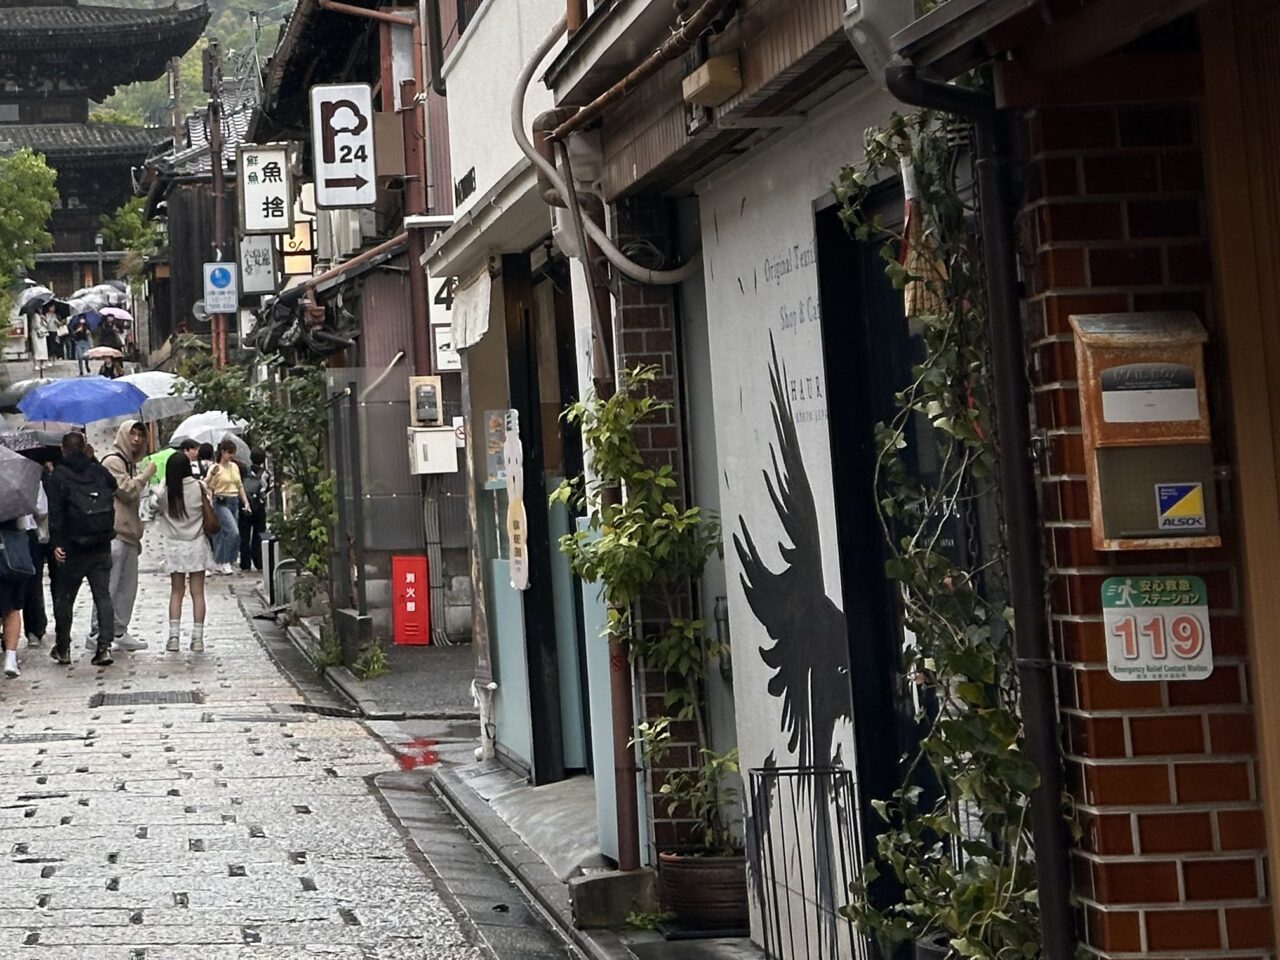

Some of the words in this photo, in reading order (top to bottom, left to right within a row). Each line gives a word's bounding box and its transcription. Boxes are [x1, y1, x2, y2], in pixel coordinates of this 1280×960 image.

[339, 144, 368, 164] 24
[246, 155, 259, 185] 鮮魚
[261, 161, 285, 218] 魚捨
[764, 247, 793, 286] Original
[779, 303, 797, 334] Shop
[1162, 517, 1204, 527] ALSOK
[1140, 579, 1191, 592] 安心救急
[1141, 593, 1199, 605] ステーション
[1113, 615, 1202, 658] 119
[1113, 666, 1145, 674] Emergency
[1187, 664, 1208, 672] Station
